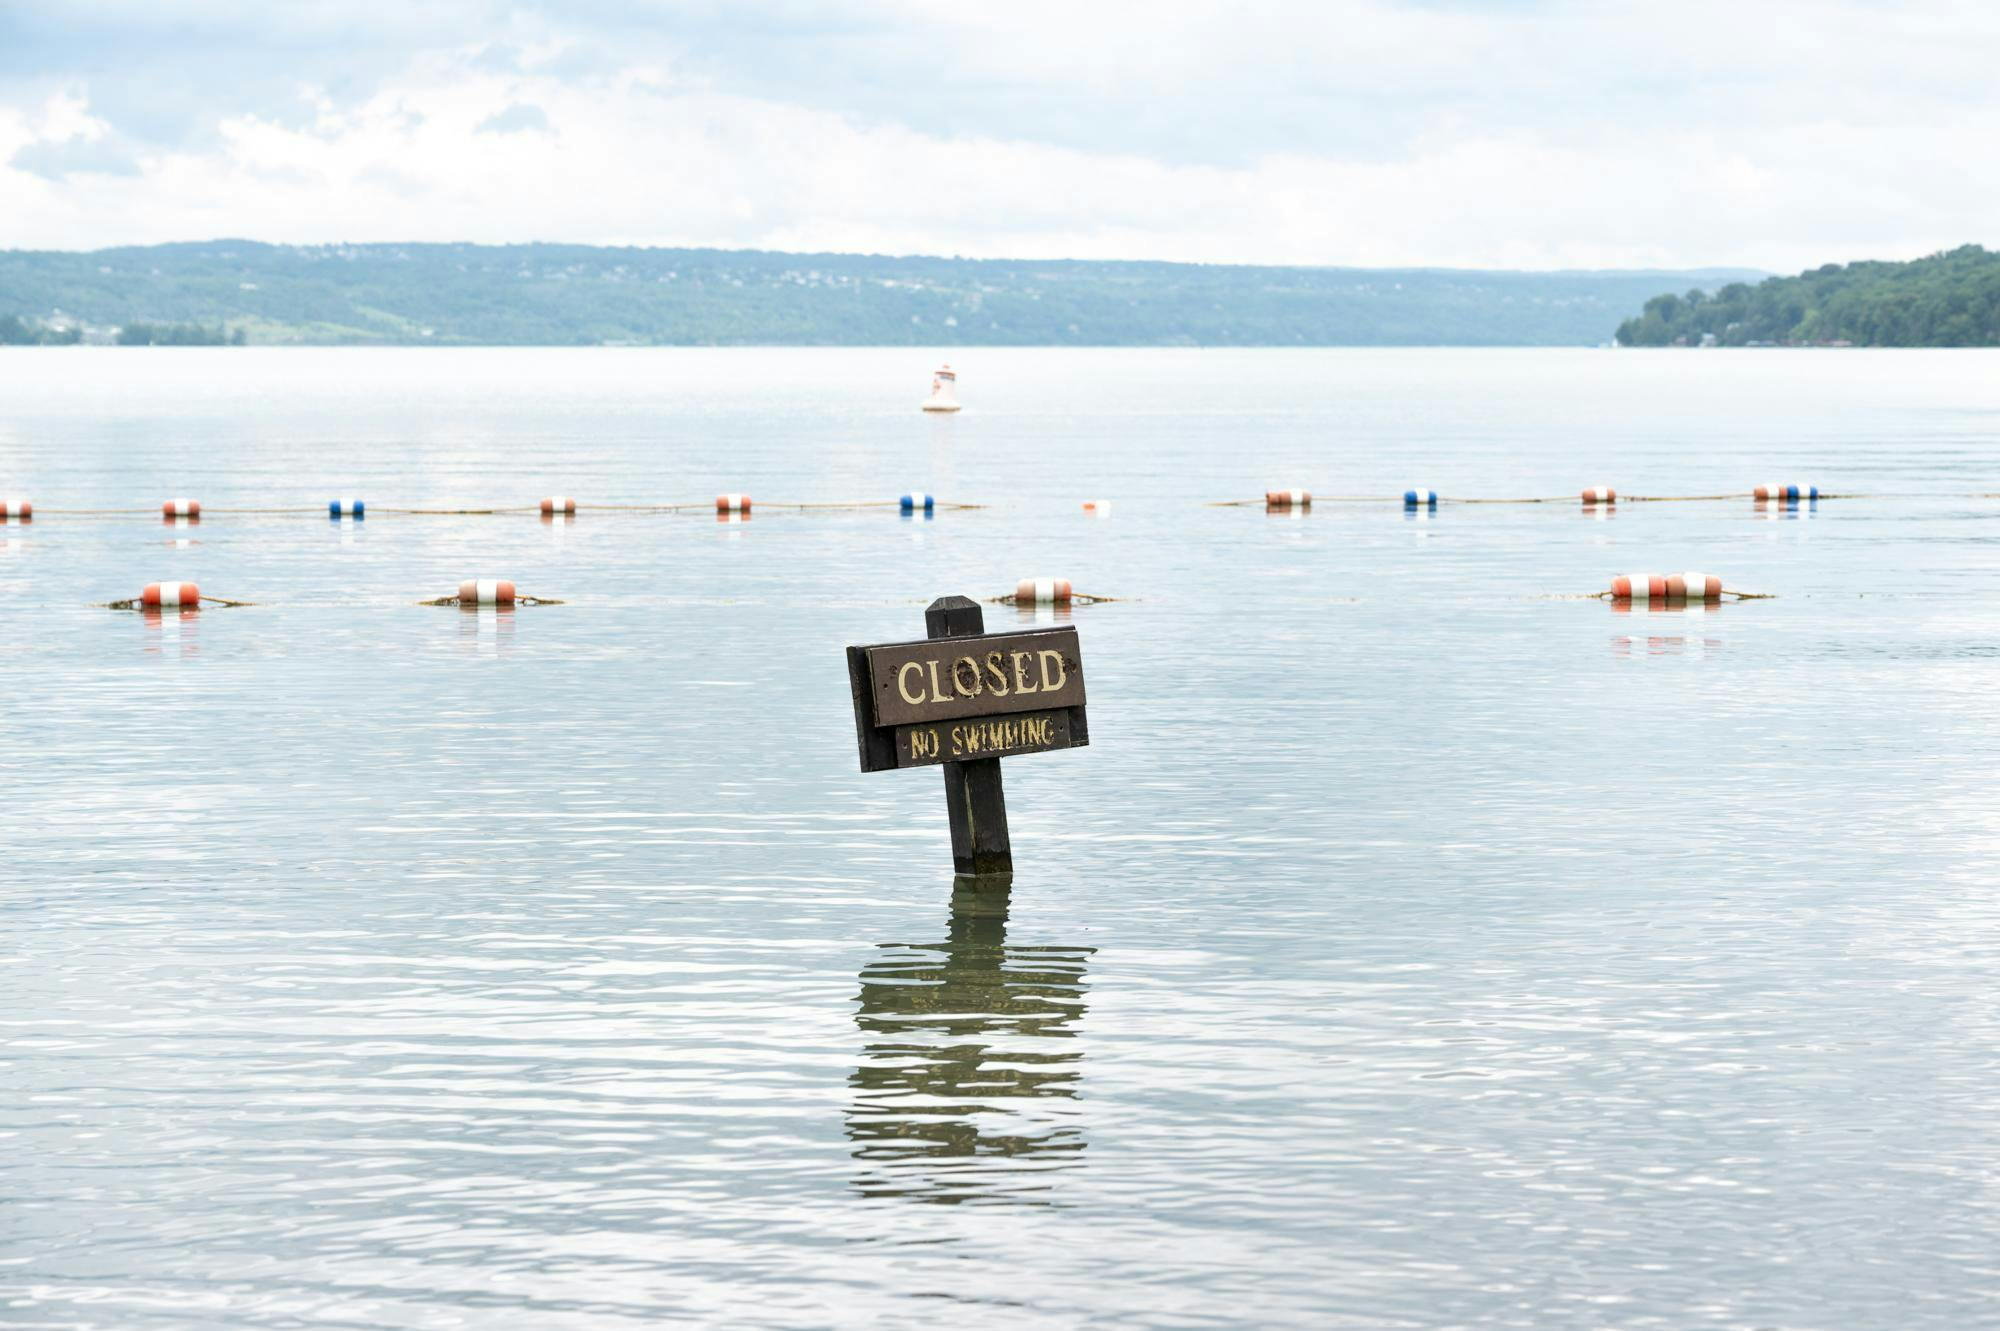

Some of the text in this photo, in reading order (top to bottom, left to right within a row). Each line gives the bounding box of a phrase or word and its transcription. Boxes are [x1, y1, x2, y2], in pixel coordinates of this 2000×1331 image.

[898, 650, 1067, 704] CLOSED
[911, 716, 1055, 759] NO SWIMMING
